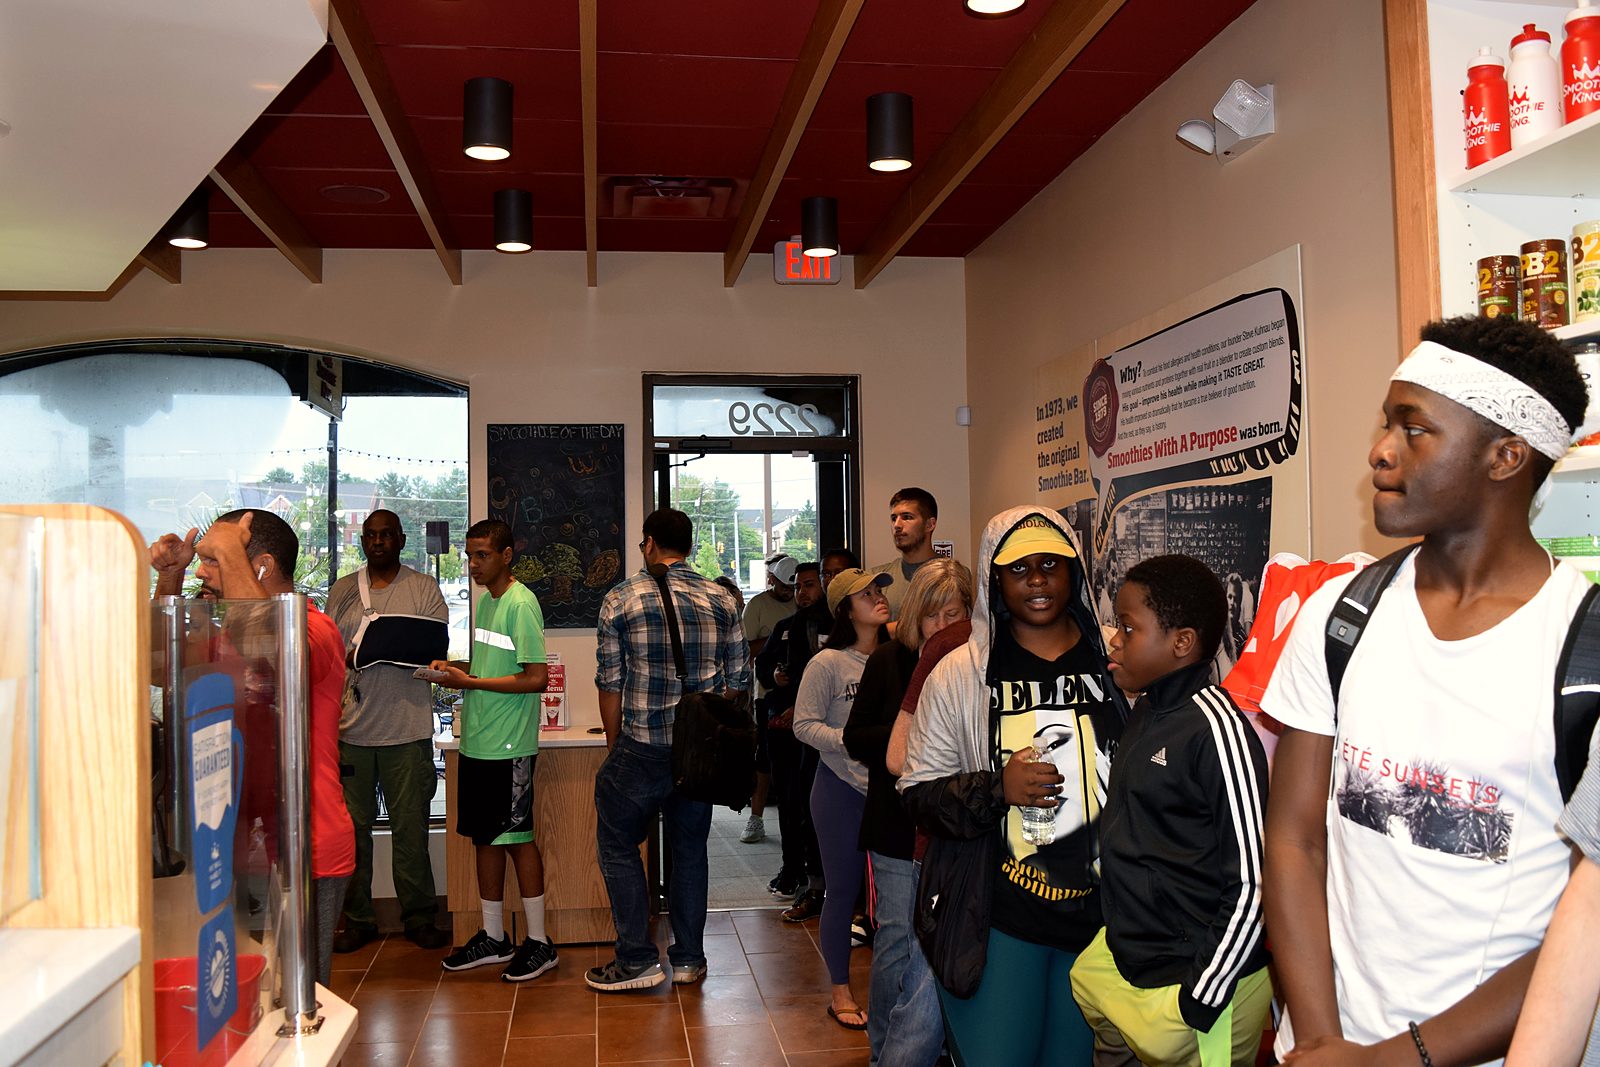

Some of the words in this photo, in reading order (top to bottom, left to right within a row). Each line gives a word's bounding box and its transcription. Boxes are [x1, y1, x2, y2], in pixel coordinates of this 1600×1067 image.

[1563, 79, 1600, 97] SMOOT
[786, 242, 830, 279] EXIT
[1520, 250, 1560, 278] PB2
[1478, 268, 1492, 290] 2
[1120, 361, 1142, 384] Why?
[1242, 330, 1253, 340] Steve
[1270, 318, 1284, 330] began
[1238, 346, 1251, 359] create
[1252, 342, 1267, 354] custom
[1129, 398, 1138, 412] goal
[1141, 393, 1159, 406] improve
[1167, 384, 1182, 398] health
[1183, 380, 1197, 392] while
[1197, 375, 1216, 388] making
[1223, 365, 1241, 380] TASTE
[1242, 359, 1265, 373] GREAT.
[1037, 407, 1044, 422] In
[1045, 398, 1065, 419] 1973,
[1066, 395, 1078, 411] we
[1093, 394, 1108, 413] SINCE
[1094, 406, 1108, 422] 1973
[600, 425, 623, 438] DAY
[1038, 422, 1064, 444] created
[1108, 444, 1152, 469] Smoothies
[1154, 436, 1178, 458] With
[1180, 434, 1188, 452] A
[1190, 426, 1238, 451] Purpose
[1239, 428, 1257, 440] was
[1258, 421, 1283, 437] born.
[1038, 451, 1050, 468] the
[1051, 441, 1080, 467] original
[1038, 470, 1072, 492] Smoothie
[1074, 468, 1089, 485] Bar.
[1016, 520, 1053, 530] IOLOG
[992, 674, 1111, 712] ELEN
[195, 748, 230, 782] GUARANTEED
[1380, 758, 1499, 804] SUNSETS
